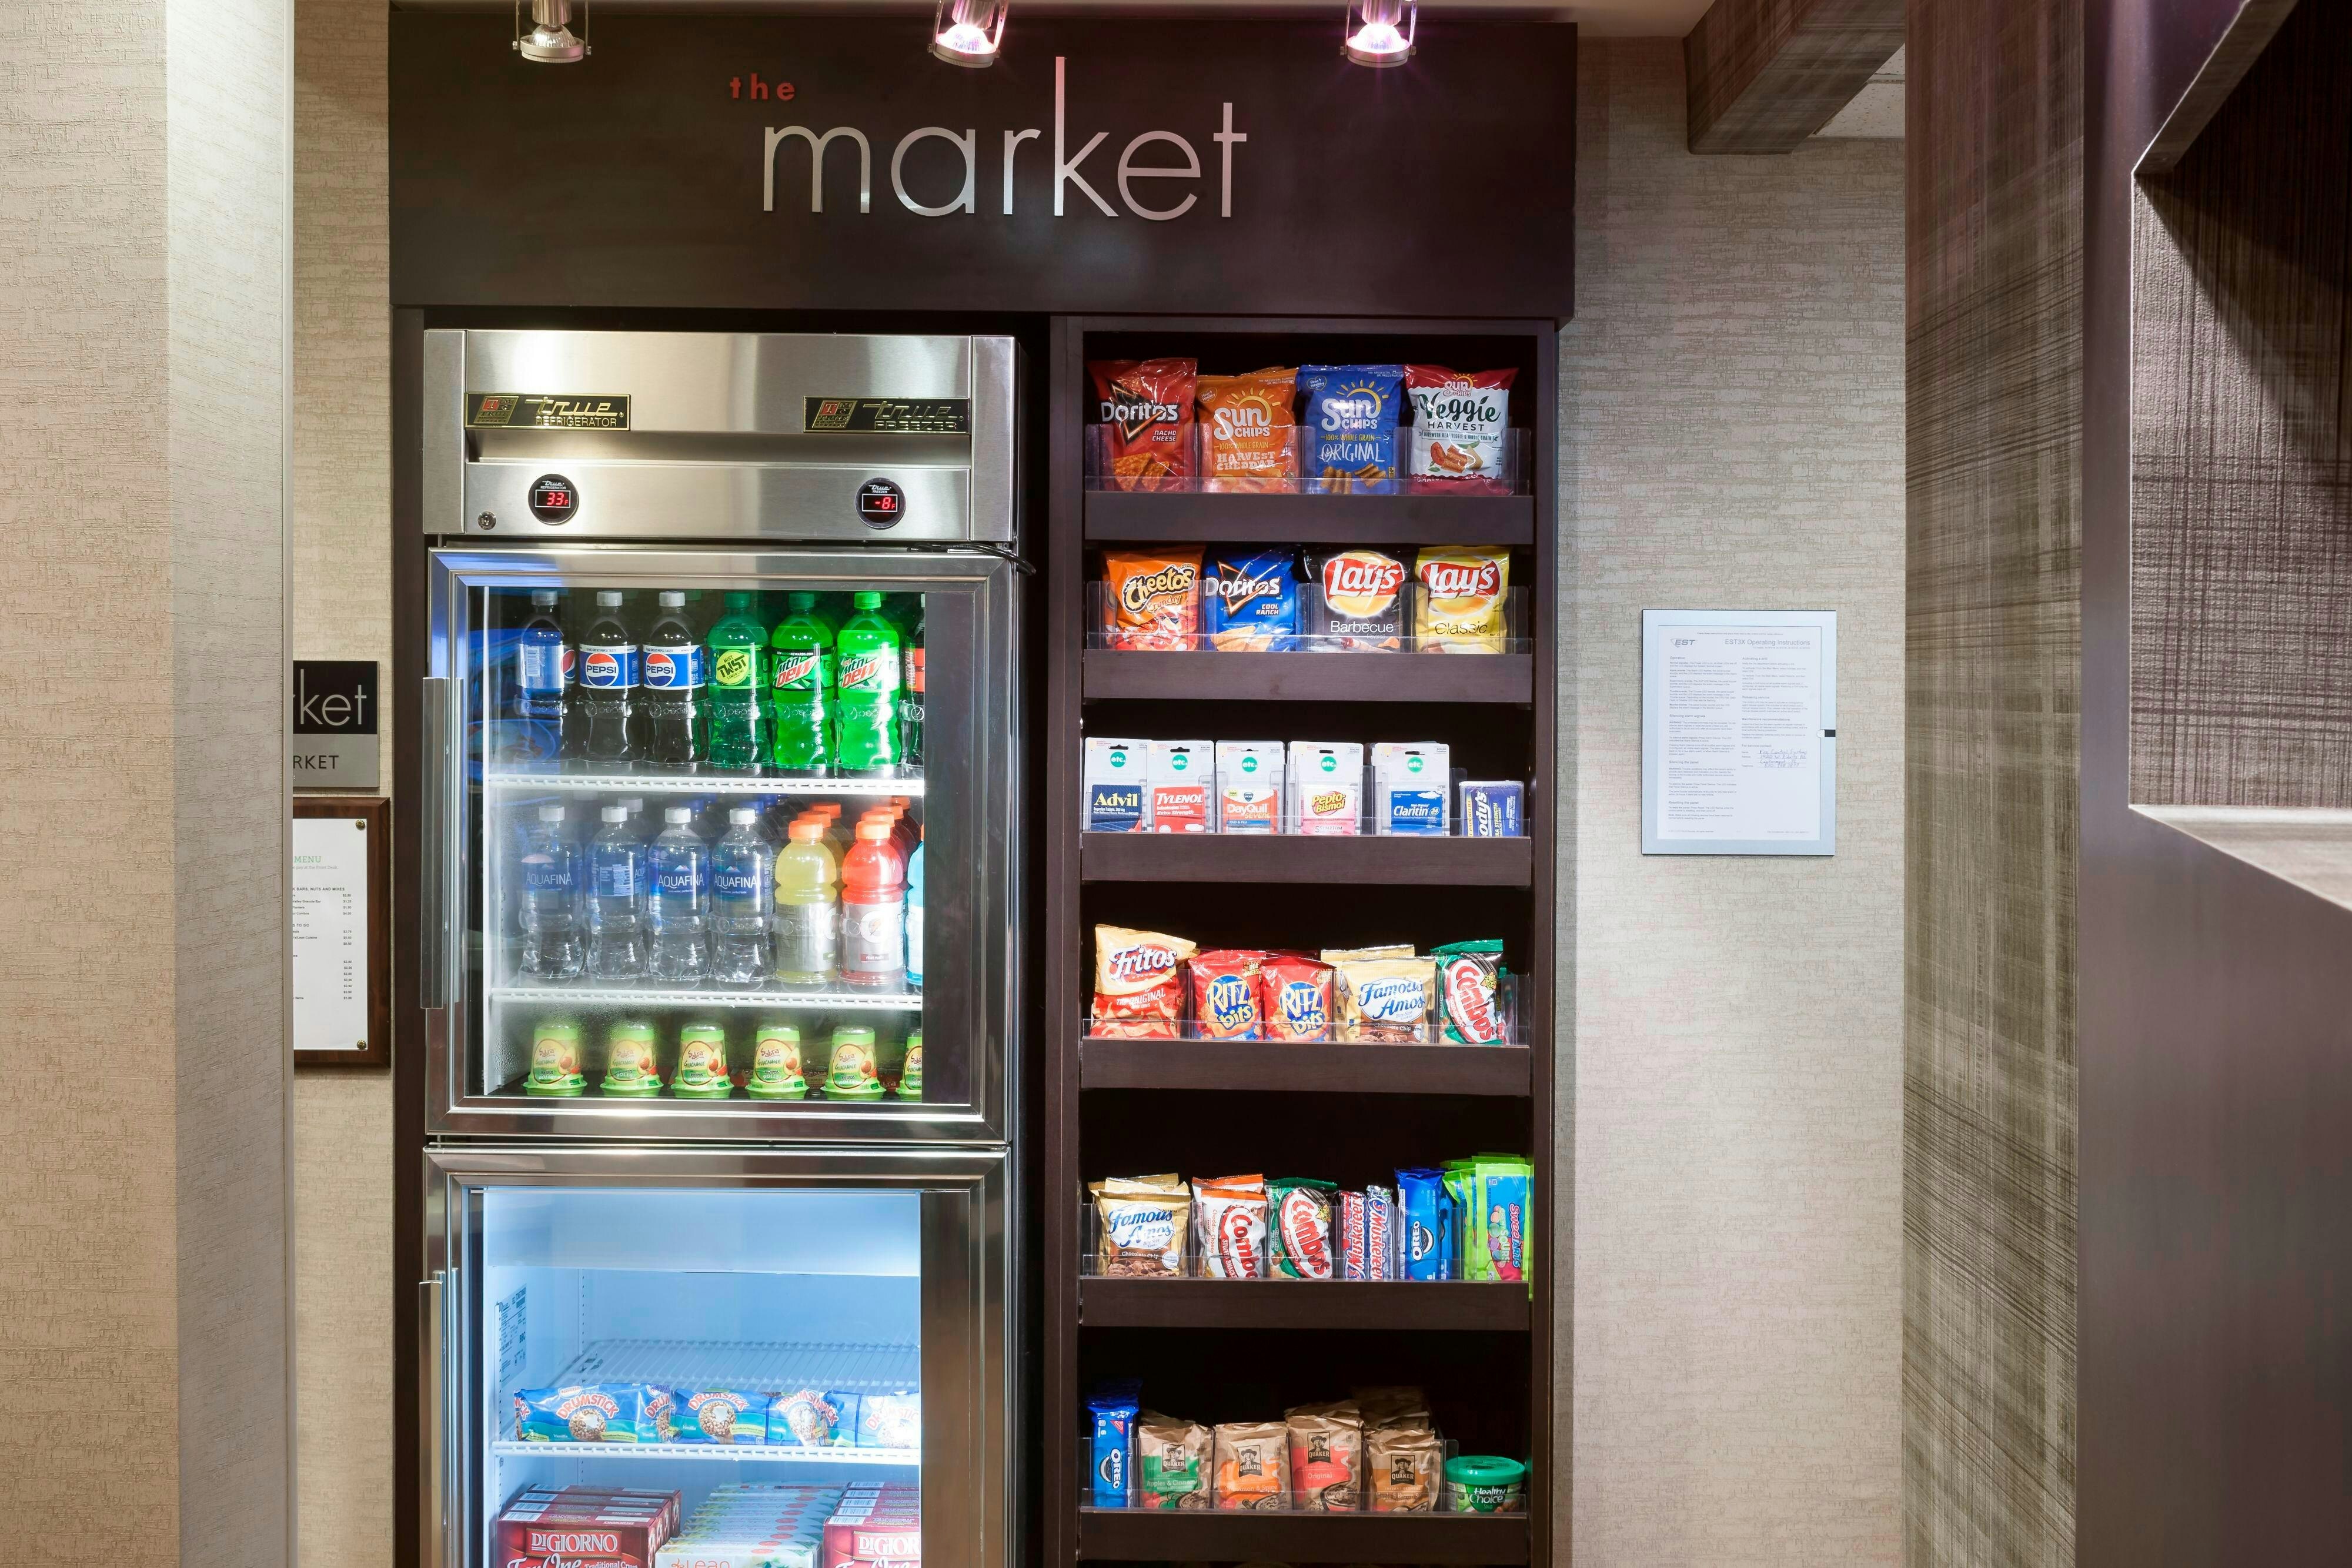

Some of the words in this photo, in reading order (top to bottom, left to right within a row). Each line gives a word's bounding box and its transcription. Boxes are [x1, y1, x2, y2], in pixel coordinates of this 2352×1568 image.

[730, 73, 795, 100] the
[763, 56, 1247, 221] market
[1443, 381, 1473, 396] Sun
[1101, 402, 1178, 422] Doritos
[1321, 398, 1381, 431] Sun
[1418, 392, 1501, 422] Veggie
[536, 416, 617, 427] REFRIGERATOR
[874, 421, 957, 430] FREEZER
[1213, 407, 1272, 440] Sun
[1341, 419, 1378, 429] CHIPS
[1428, 422, 1484, 431] HARVEST
[1234, 427, 1270, 437] CHIPS
[1217, 451, 1275, 463] HARVEST
[1319, 442, 1385, 463] ORIGINAL
[1216, 459, 1275, 470] CHEDDAR
[1206, 577, 1281, 596] Doritos
[1329, 560, 1400, 597] Lay's
[1430, 564, 1495, 599] Lay's
[1124, 567, 1194, 610] Cheetos
[1147, 594, 1181, 613] Crunchy
[1331, 621, 1394, 633] Barbecue
[1435, 620, 1488, 634] Classic
[587, 665, 616, 673] PEPSI
[646, 665, 673, 674] PEPSI
[293, 668, 367, 726] ket
[293, 755, 339, 769] RKET
[1094, 793, 1138, 807] Advil
[1156, 793, 1204, 805] TYLENOL
[1312, 791, 1346, 806] Pepto-
[1227, 804, 1268, 815] DayQuil
[1316, 800, 1345, 814] Bismol
[1394, 805, 1428, 816] Claritin
[526, 872, 573, 888] AQUAFINA
[658, 874, 704, 888] AQUAFINA
[714, 875, 763, 888] AQUAFINA
[1109, 945, 1177, 980] Fritos
[1126, 988, 1165, 1004] ORIGINAL
[1208, 980, 1250, 1012] RITZ
[1358, 981, 1422, 1006] Famous
[1281, 988, 1320, 1017] RITZ
[1372, 996, 1425, 1019] Amos
[1456, 965, 1494, 1040] Combos
[1220, 1006, 1253, 1028] bits
[1292, 1013, 1324, 1034] bits
[539, 1048, 555, 1057] Sabra
[617, 1049, 635, 1058] Sabra
[688, 1049, 704, 1059] Sabra
[761, 1048, 780, 1058] Sabra
[838, 1053, 856, 1062] Sabra
[1373, 1201, 1385, 1213] 3
[1108, 1210, 1172, 1234] Famous
[1120, 1225, 1172, 1248] Amos
[1292, 1200, 1331, 1275] Combos
[1347, 1194, 1365, 1269] Musketeers
[1412, 1221, 1424, 1261] OREO
[1289, 1243, 1299, 1261] SNACKS
[557, 1394, 619, 1419] DRUMSTICK
[689, 1393, 749, 1410] DRUMSTICK
[1111, 1449, 1122, 1489] OREO
[1470, 1493, 1505, 1503] Choice
[1474, 1487, 1506, 1496] Healthy
[532, 1533, 617, 1552] DIGIORNO
